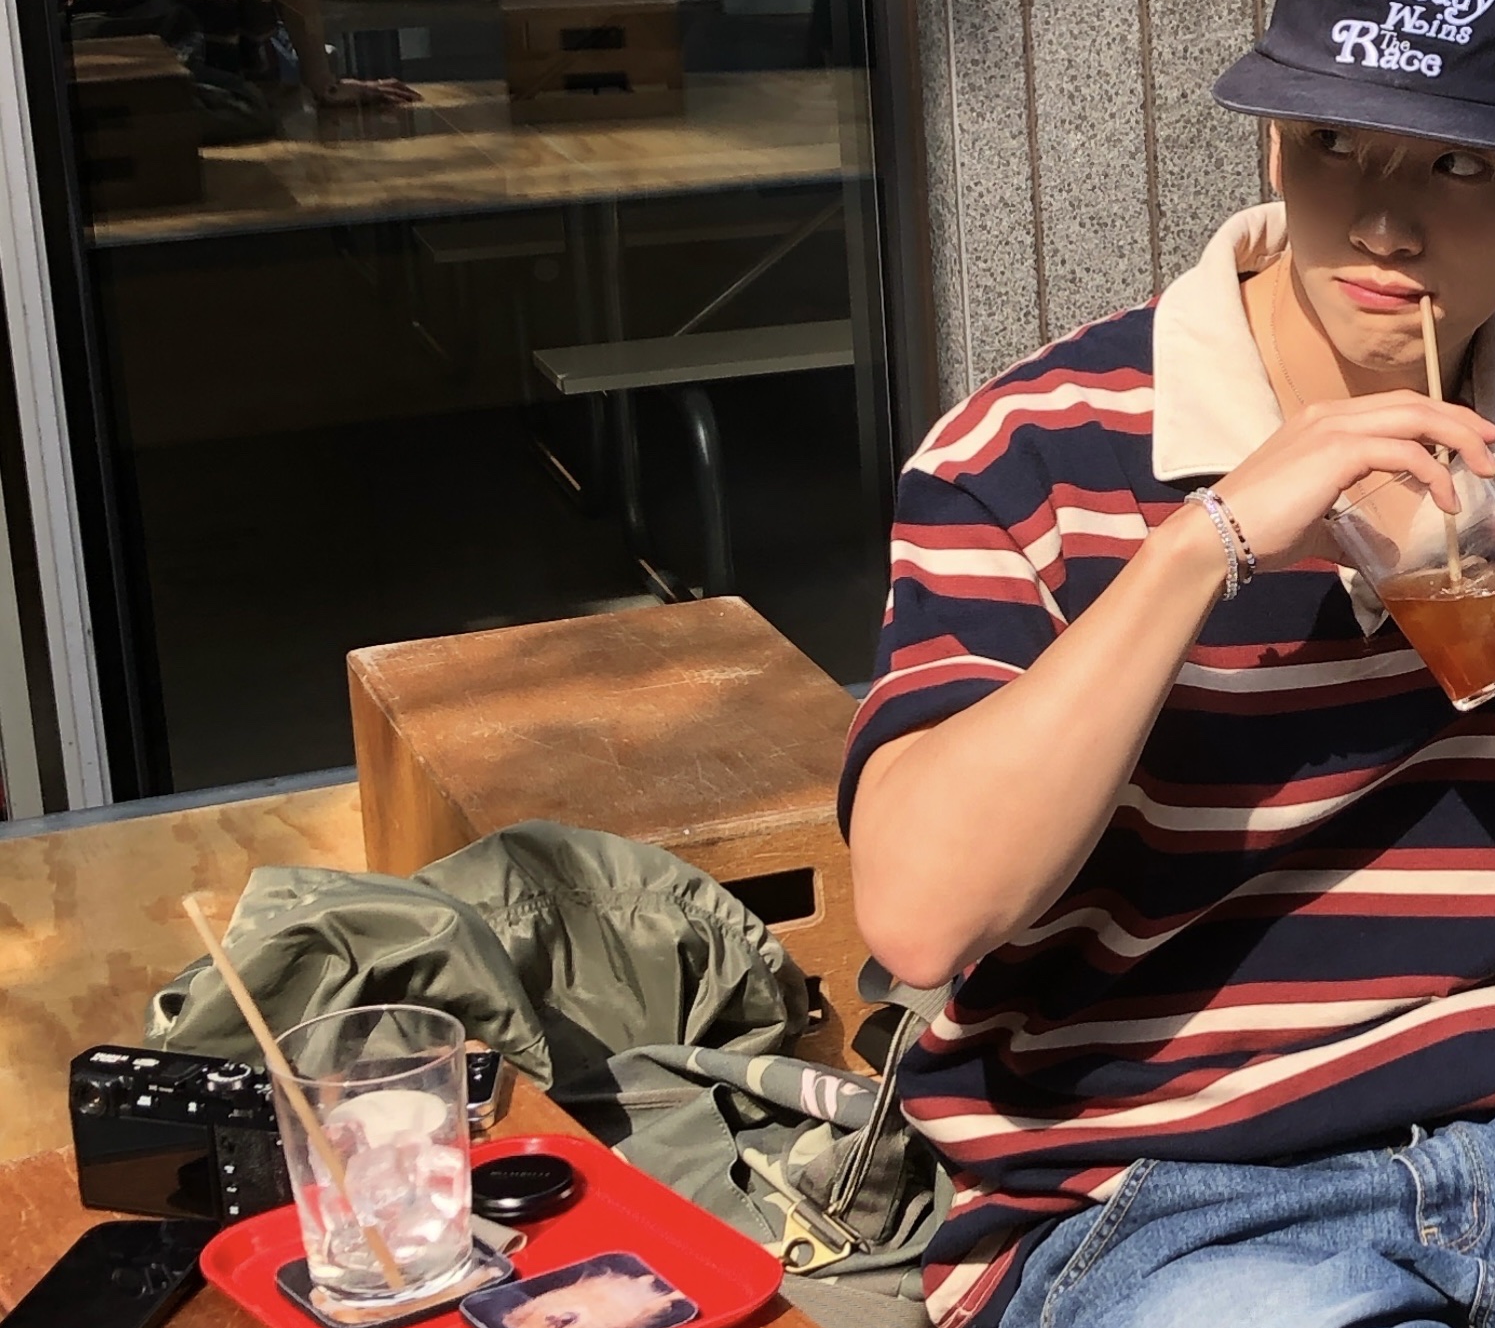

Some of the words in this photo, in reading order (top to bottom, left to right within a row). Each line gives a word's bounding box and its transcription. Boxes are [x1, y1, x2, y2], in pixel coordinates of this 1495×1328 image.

[1380, 2, 1473, 45] Wins
[1380, 30, 1411, 52] The
[1332, 19, 1443, 78] Race
